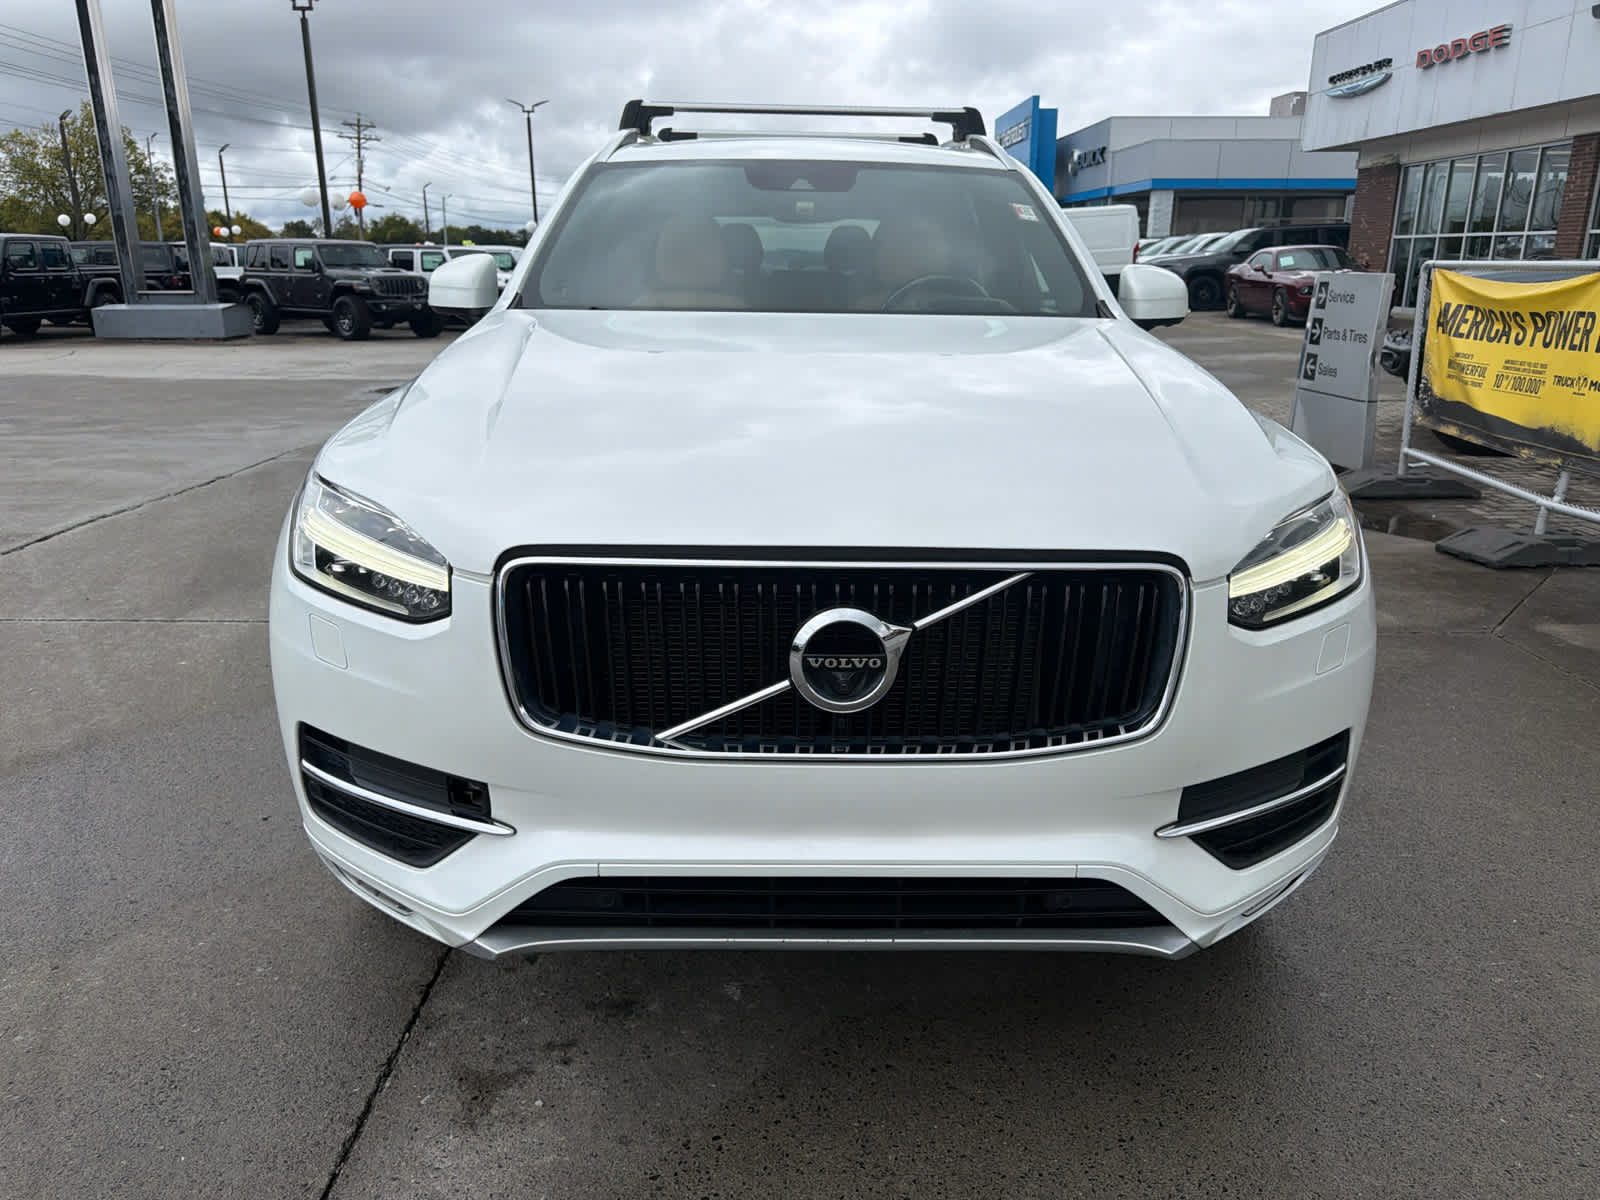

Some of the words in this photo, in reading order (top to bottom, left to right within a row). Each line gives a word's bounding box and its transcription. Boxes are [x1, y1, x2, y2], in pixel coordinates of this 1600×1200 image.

[1416, 24, 1513, 70] DODGE
[1328, 290, 1355, 304] Service
[1322, 327, 1340, 341] Parts
[1349, 329, 1368, 344] Tires
[1436, 302, 1528, 346] AMERICA'S
[1529, 310, 1597, 353] POWER
[1317, 360, 1337, 378] Sales
[1552, 375, 1575, 389] TRUCK
[807, 657, 882, 668] VOLVO
